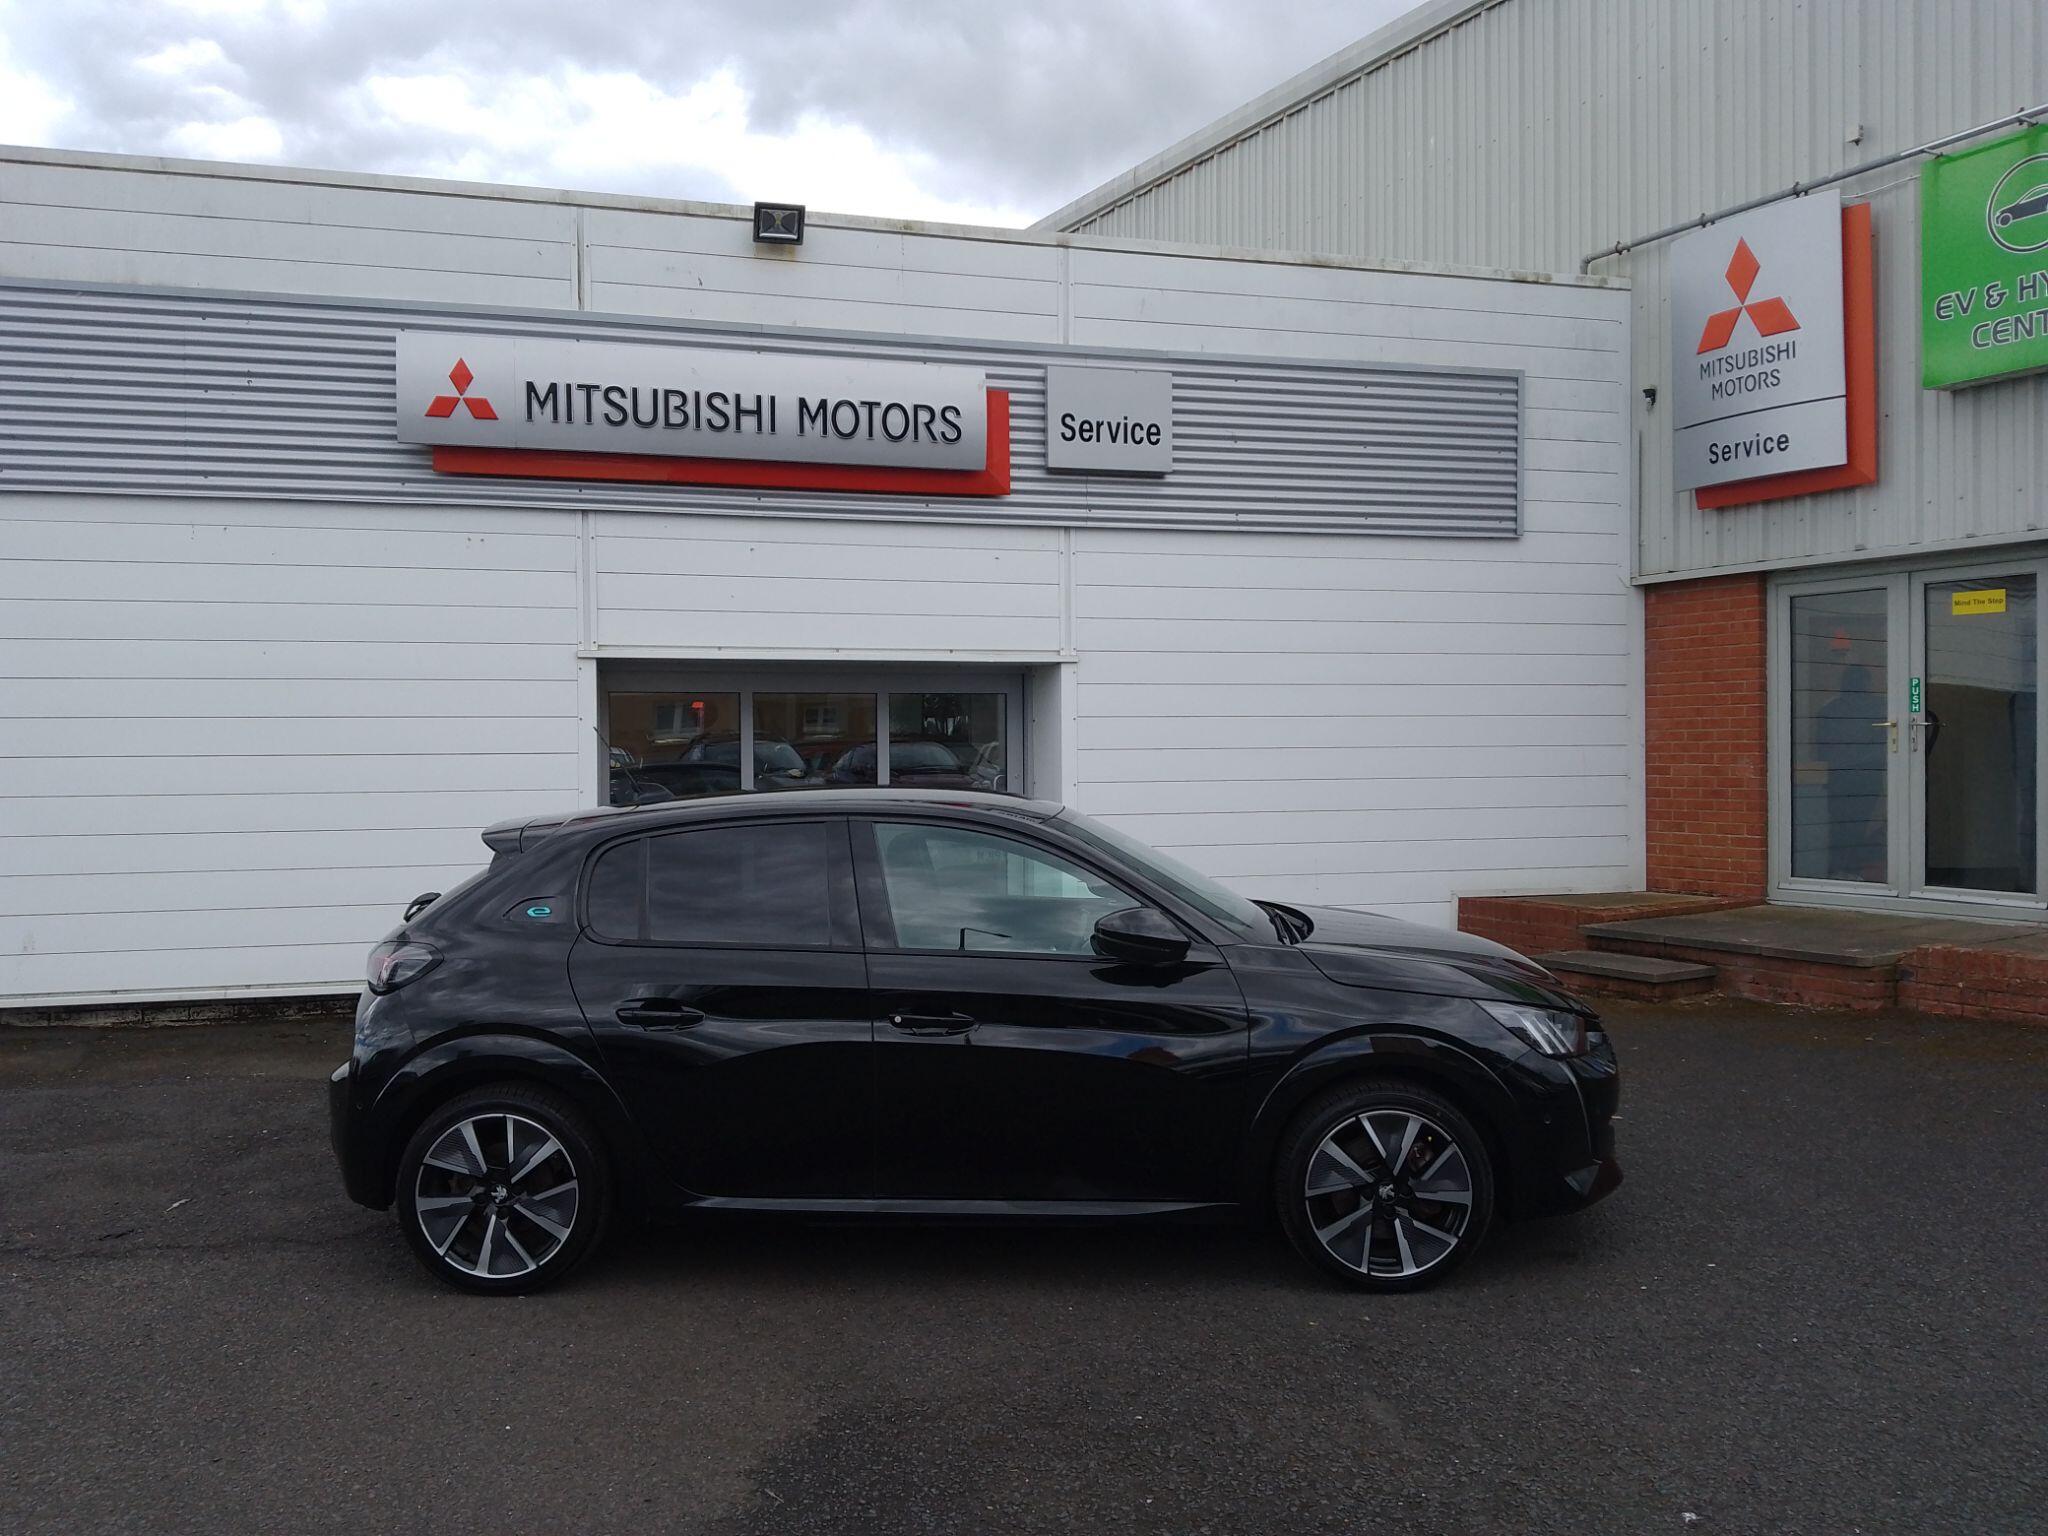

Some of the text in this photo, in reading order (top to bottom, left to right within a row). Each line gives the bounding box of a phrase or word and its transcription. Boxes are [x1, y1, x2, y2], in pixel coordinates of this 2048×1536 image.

[1935, 287, 1977, 320] EV
[1984, 281, 2009, 309] &
[1700, 340, 1797, 381] MITSUBISHI
[1711, 368, 1781, 401] MOTORS
[525, 380, 963, 444] MITSUBISHI MOTORS
[1060, 412, 1162, 446] Service
[1708, 433, 1790, 464] Service
[1987, 597, 2004, 605] Step
[1911, 678, 1920, 712] PUSH
